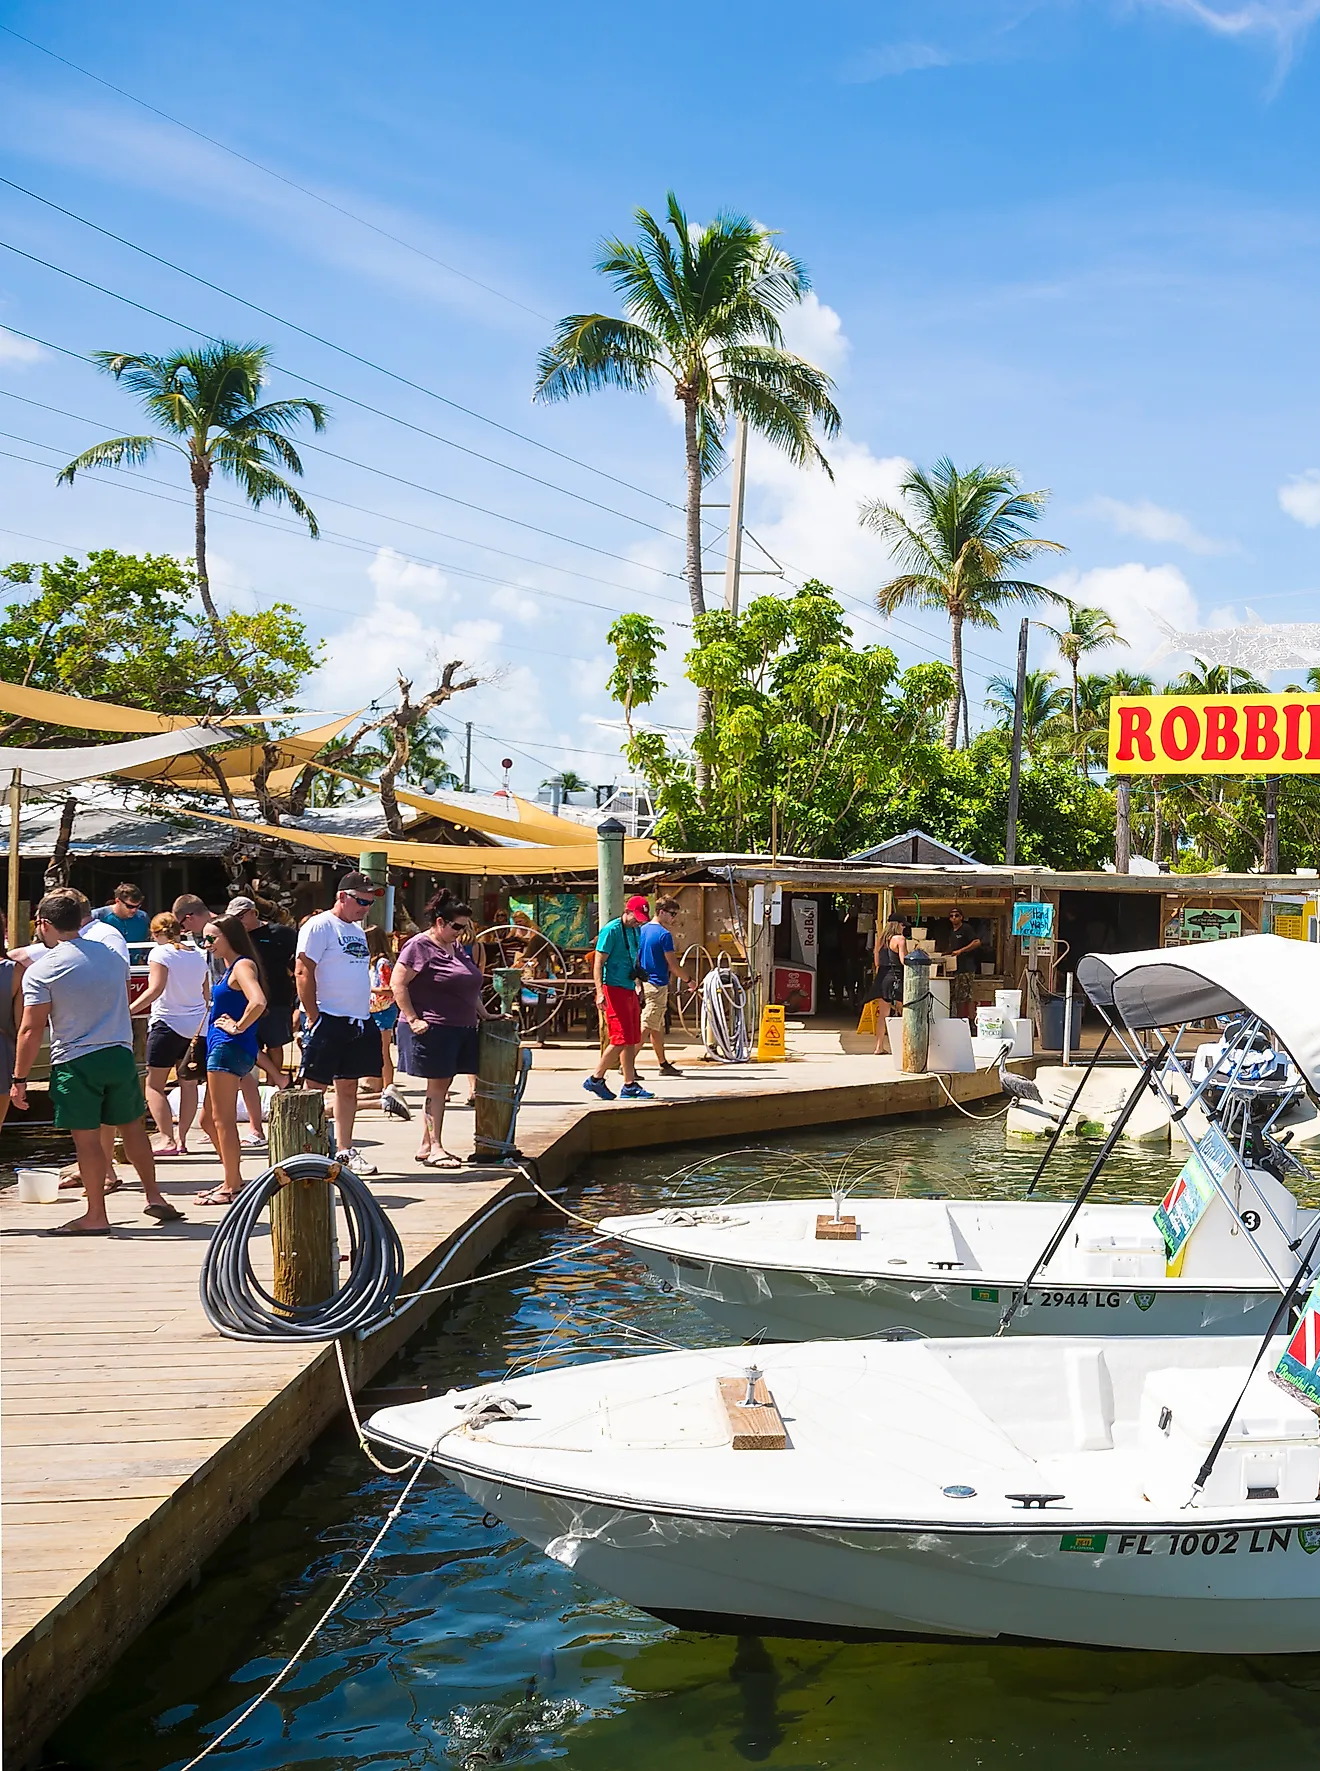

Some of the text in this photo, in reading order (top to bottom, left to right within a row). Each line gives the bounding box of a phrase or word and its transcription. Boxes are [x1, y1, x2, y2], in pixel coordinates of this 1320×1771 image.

[1244, 1212, 1256, 1230] 3
[1040, 1291, 1089, 1308] 2944
[1095, 1292, 1121, 1308] LG
[1117, 1526, 1292, 1556] FL 1002 LN
